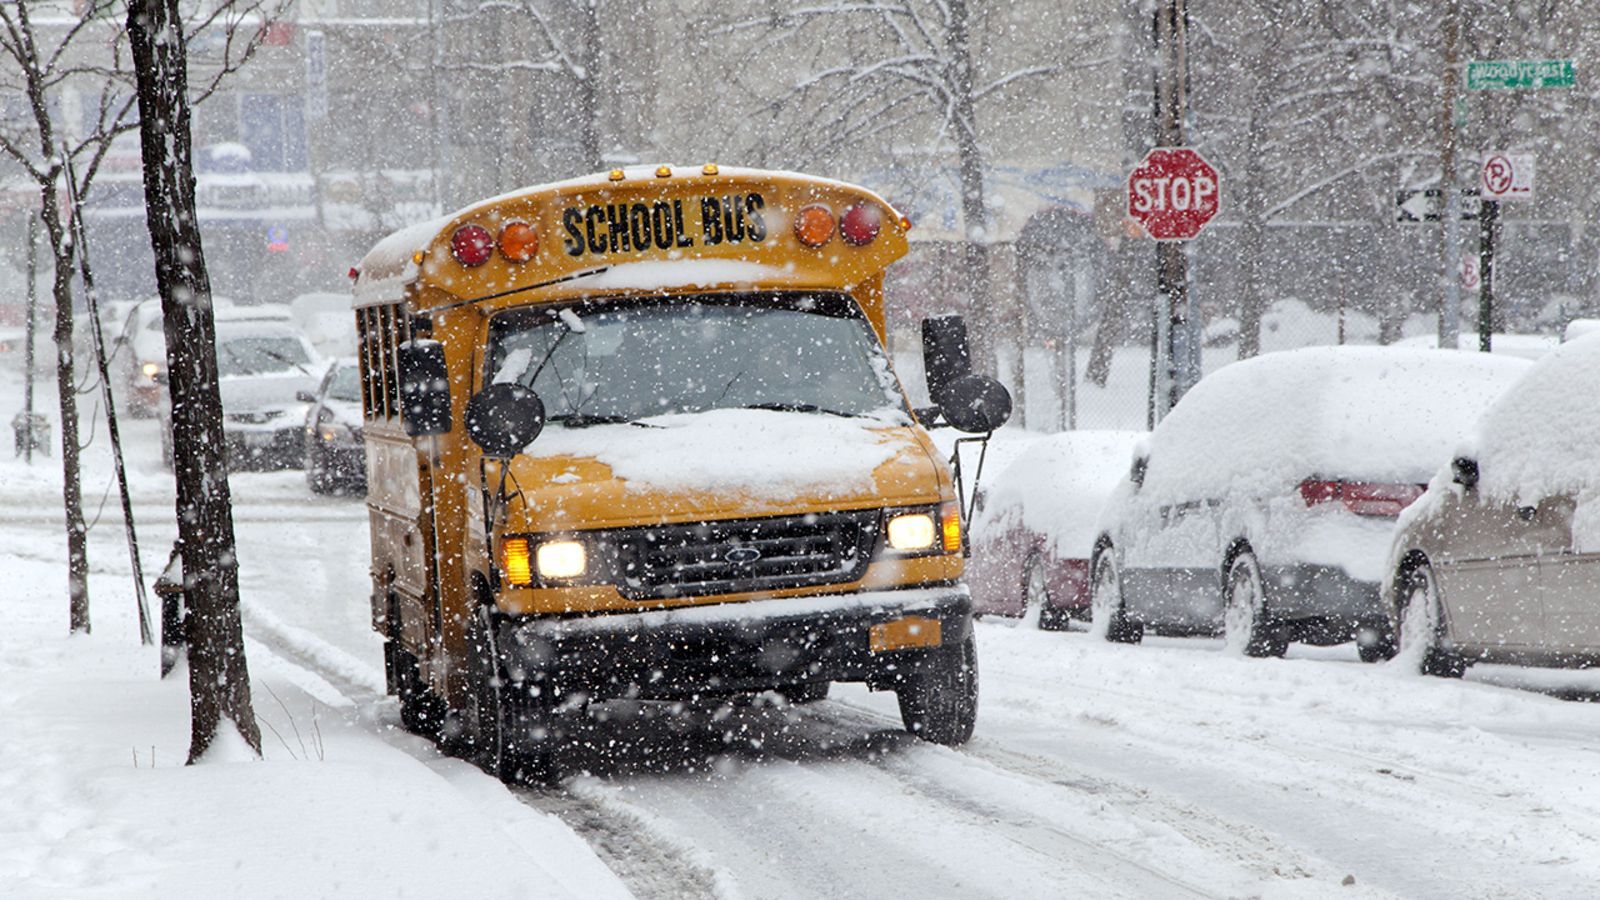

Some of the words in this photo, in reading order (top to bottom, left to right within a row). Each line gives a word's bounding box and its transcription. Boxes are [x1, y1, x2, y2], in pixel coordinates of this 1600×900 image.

[1133, 176, 1215, 212] STOP
[563, 199, 694, 257] SCHOOL
[701, 192, 767, 246] BUS
